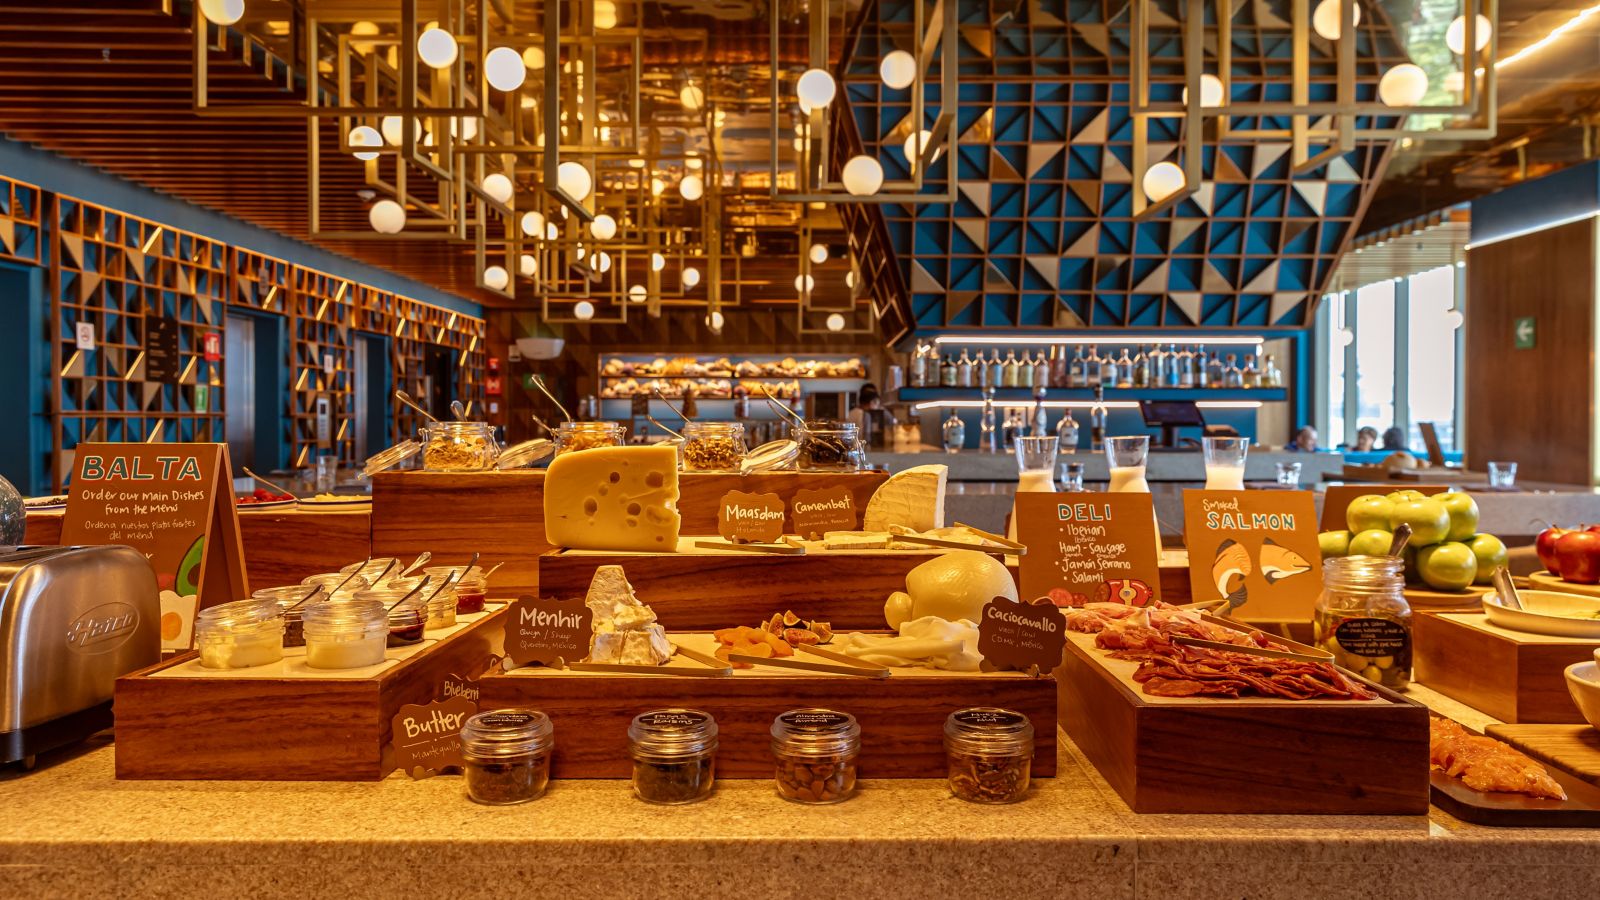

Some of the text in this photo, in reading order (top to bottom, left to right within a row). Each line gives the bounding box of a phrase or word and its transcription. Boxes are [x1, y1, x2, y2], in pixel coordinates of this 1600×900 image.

[81, 455, 202, 481] BALTA
[82, 489, 118, 501] Order
[119, 492, 140, 501] our
[172, 489, 205, 501] Dishes
[105, 503, 130, 515] from
[132, 503, 149, 515] the
[726, 504, 785, 522] Maasdam
[795, 495, 850, 514] Camembert
[1058, 503, 1112, 521] DELI
[1202, 497, 1240, 513] Smoked
[1067, 523, 1106, 537] Iberian
[1206, 511, 1296, 531] SALMON
[1059, 541, 1082, 554] Ham
[1088, 541, 1127, 556] Sausage
[1061, 558, 1097, 573] Jamón
[1071, 572, 1105, 584] Salami
[520, 606, 583, 630] Menhir
[987, 606, 1057, 633] Caciocavallo
[402, 709, 466, 739] Butter
